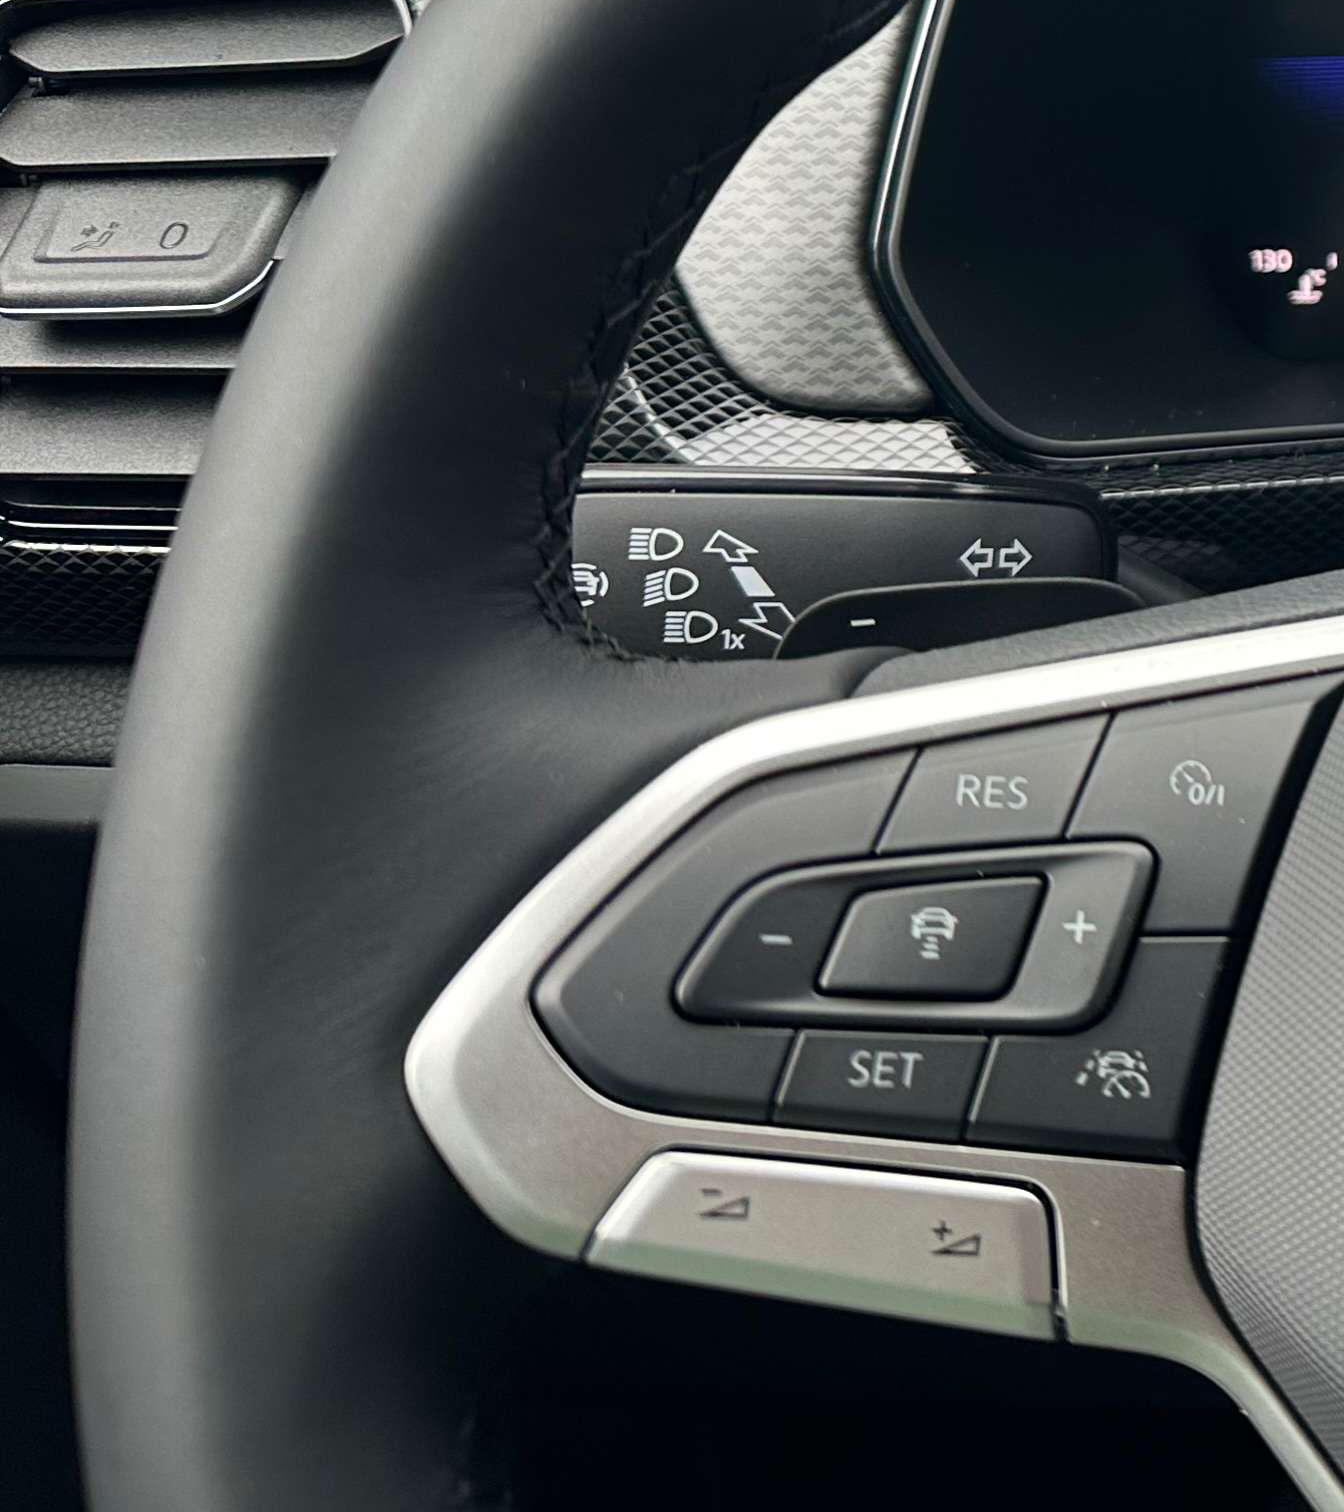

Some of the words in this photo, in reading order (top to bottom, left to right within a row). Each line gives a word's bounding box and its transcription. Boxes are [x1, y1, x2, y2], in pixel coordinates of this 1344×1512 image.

[720, 628, 746, 651] 1x
[956, 774, 1028, 810] RES
[848, 1051, 923, 1088] SET
